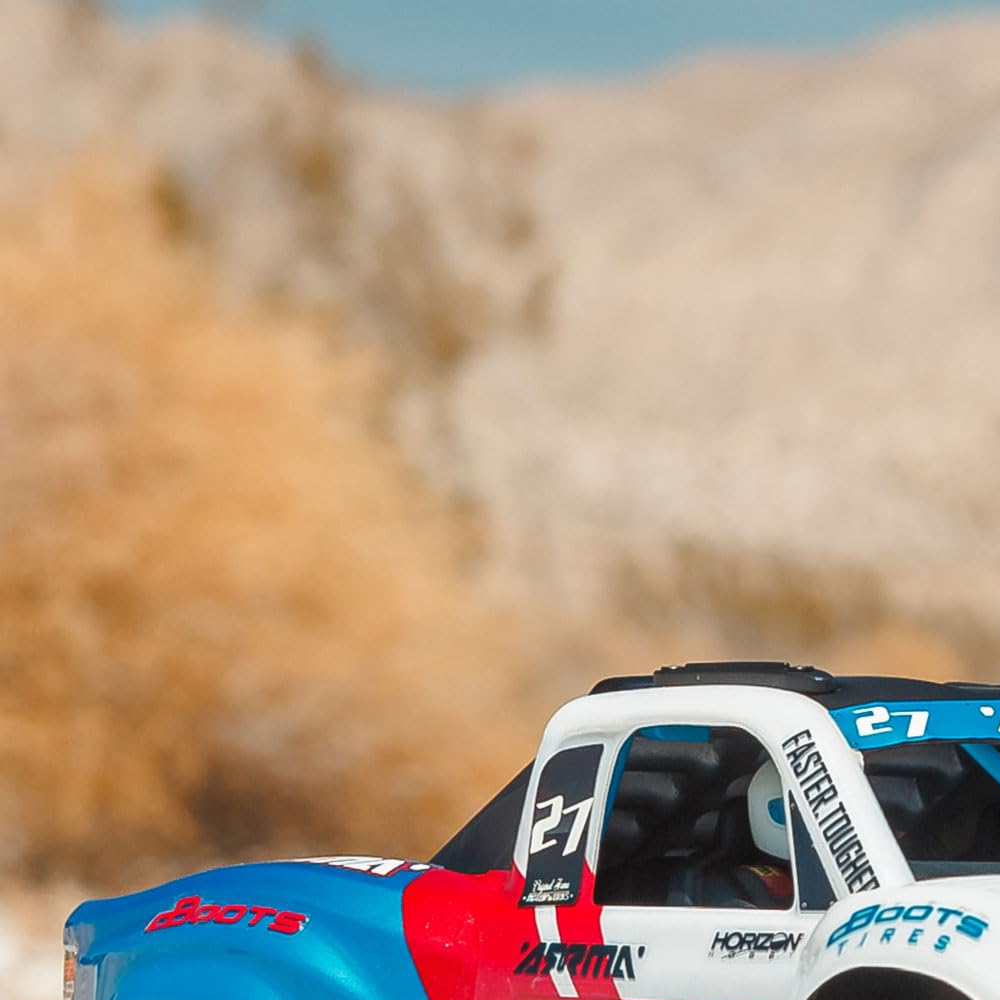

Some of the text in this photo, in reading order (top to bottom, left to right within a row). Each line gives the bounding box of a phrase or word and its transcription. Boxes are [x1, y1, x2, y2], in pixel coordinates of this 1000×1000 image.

[852, 706, 929, 738] 27
[530, 795, 594, 856] 27
[144, 895, 309, 935] BOOTS
[826, 904, 989, 941] BOOTS
[711, 931, 803, 952] HORIZON
[837, 927, 952, 954] TIRES
